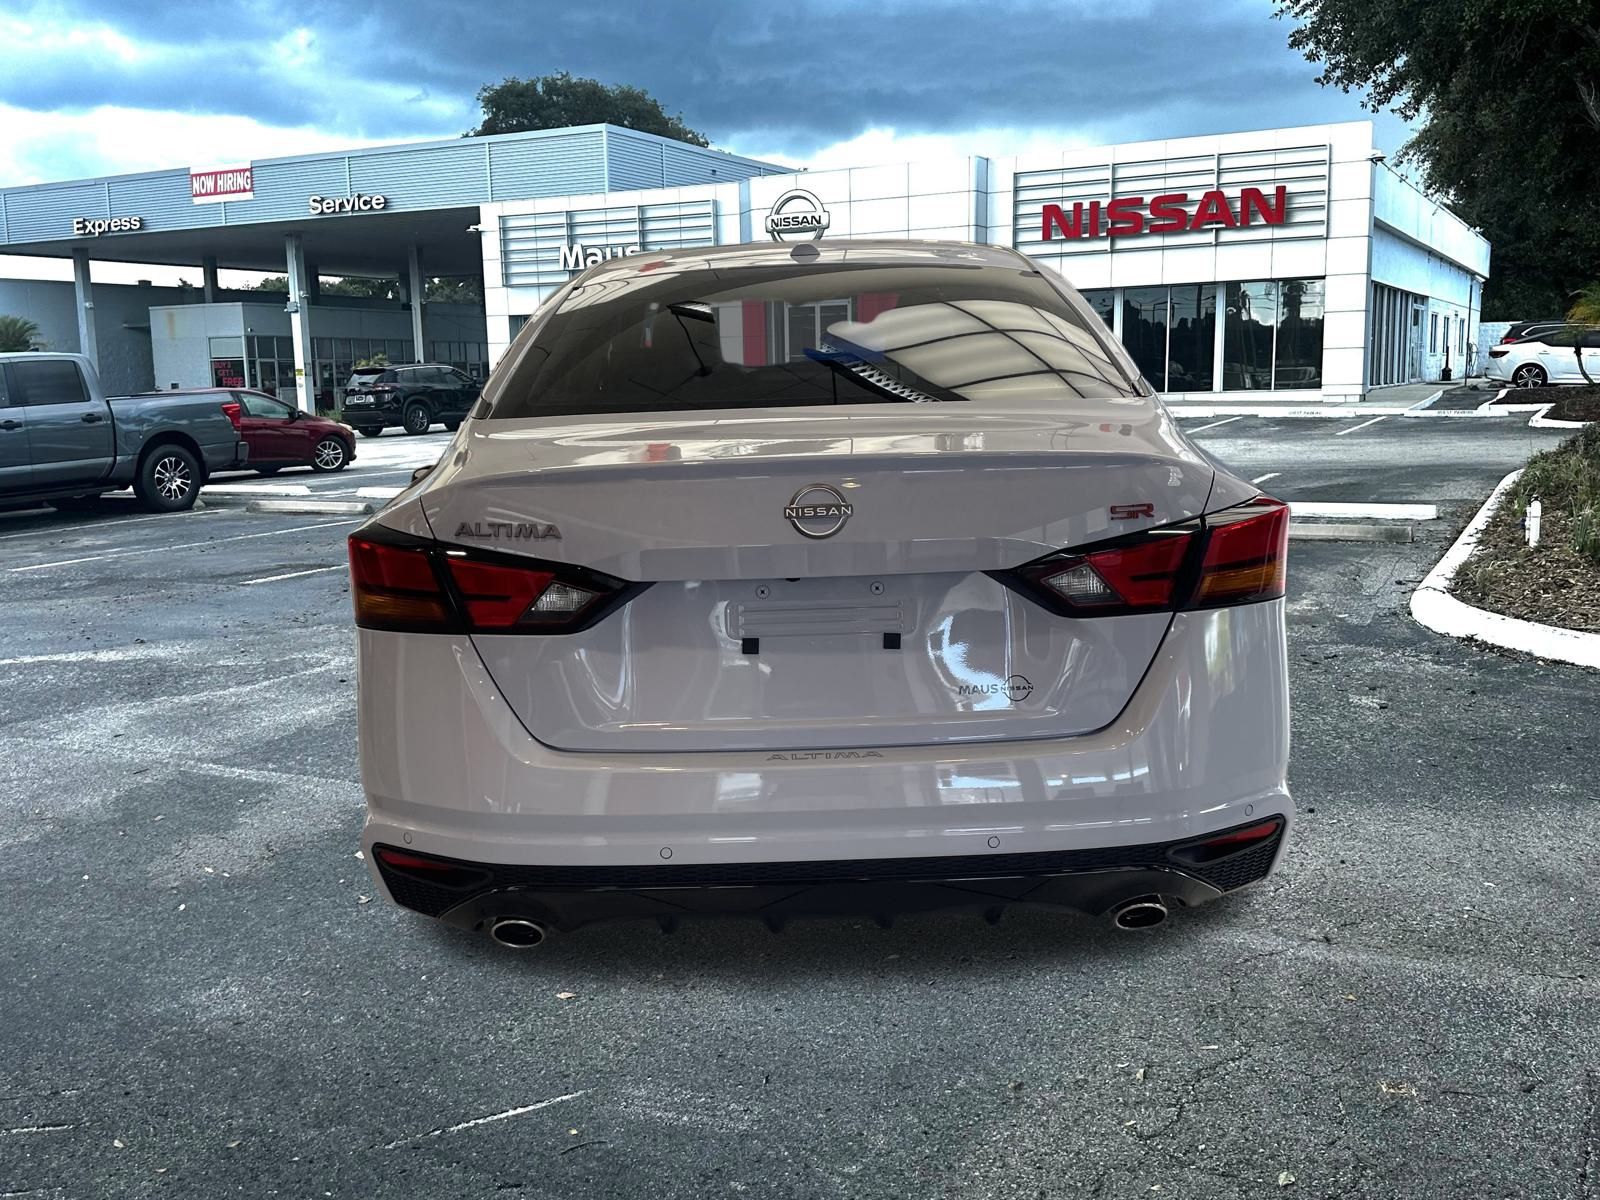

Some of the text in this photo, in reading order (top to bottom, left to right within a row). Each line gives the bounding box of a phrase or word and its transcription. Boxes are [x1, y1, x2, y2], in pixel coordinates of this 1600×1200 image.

[192, 171, 251, 195] NOW HIRING
[308, 193, 385, 215] Service
[1042, 185, 1287, 240] NISSAN
[73, 215, 141, 236] Express
[770, 215, 822, 228] NISSAN
[222, 377, 245, 387] FREE
[785, 506, 852, 517] NISSAN
[1110, 503, 1154, 520] SR
[454, 522, 562, 539] ALTIMA
[958, 684, 999, 695] MAUS
[766, 751, 884, 761] ALTIMA
